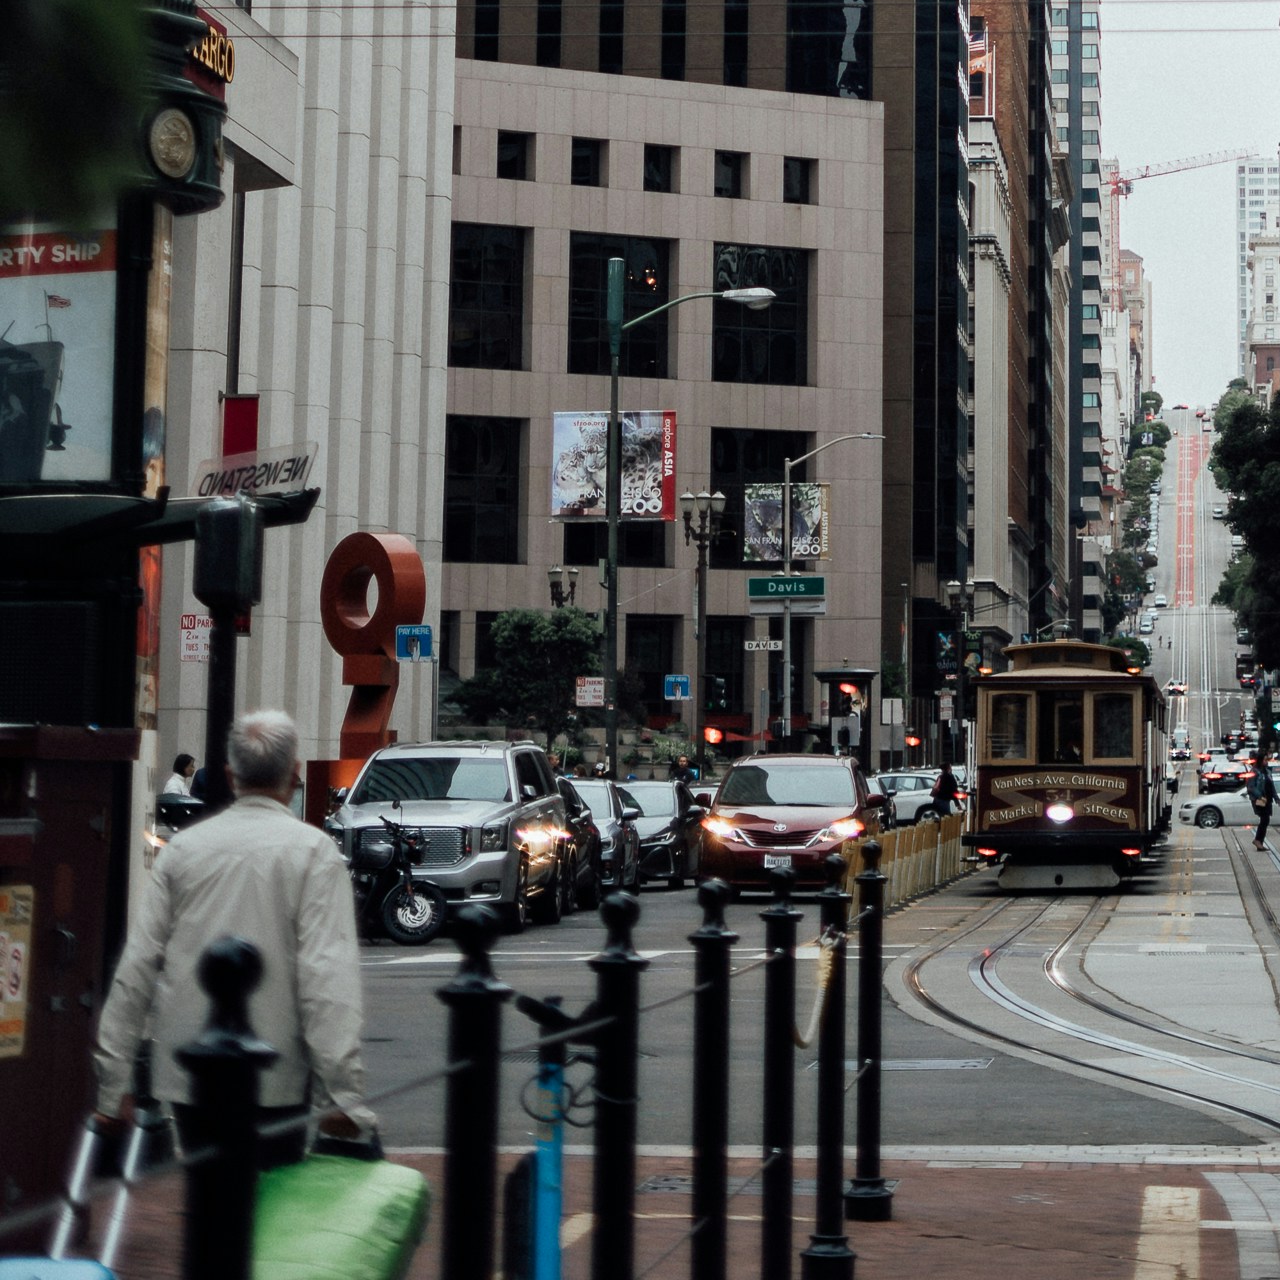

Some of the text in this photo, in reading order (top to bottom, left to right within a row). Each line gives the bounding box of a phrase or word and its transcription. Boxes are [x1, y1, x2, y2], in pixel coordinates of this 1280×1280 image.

[193, 26, 235, 83] ARGO
[51, 242, 101, 262] SHIP
[573, 419, 606, 427] sfzoo.org
[664, 418, 674, 477] explore ASIA
[579, 488, 606, 498] FRAN
[622, 487, 661, 498] CISCO
[621, 498, 663, 514] ZOO
[821, 511, 829, 553] AUSTRALIA
[744, 536, 820, 545] SAN FRAN CISCO
[792, 544, 821, 555] ZOO
[768, 582, 805, 592] Davis
[182, 616, 194, 629] NO
[398, 627, 430, 635] PAY HERE
[185, 643, 199, 652] TUES
[747, 642, 779, 650] DAVIS
[994, 779, 1013, 789] Van
[1071, 775, 1126, 790] California
[989, 802, 1128, 821] & Market Streets
